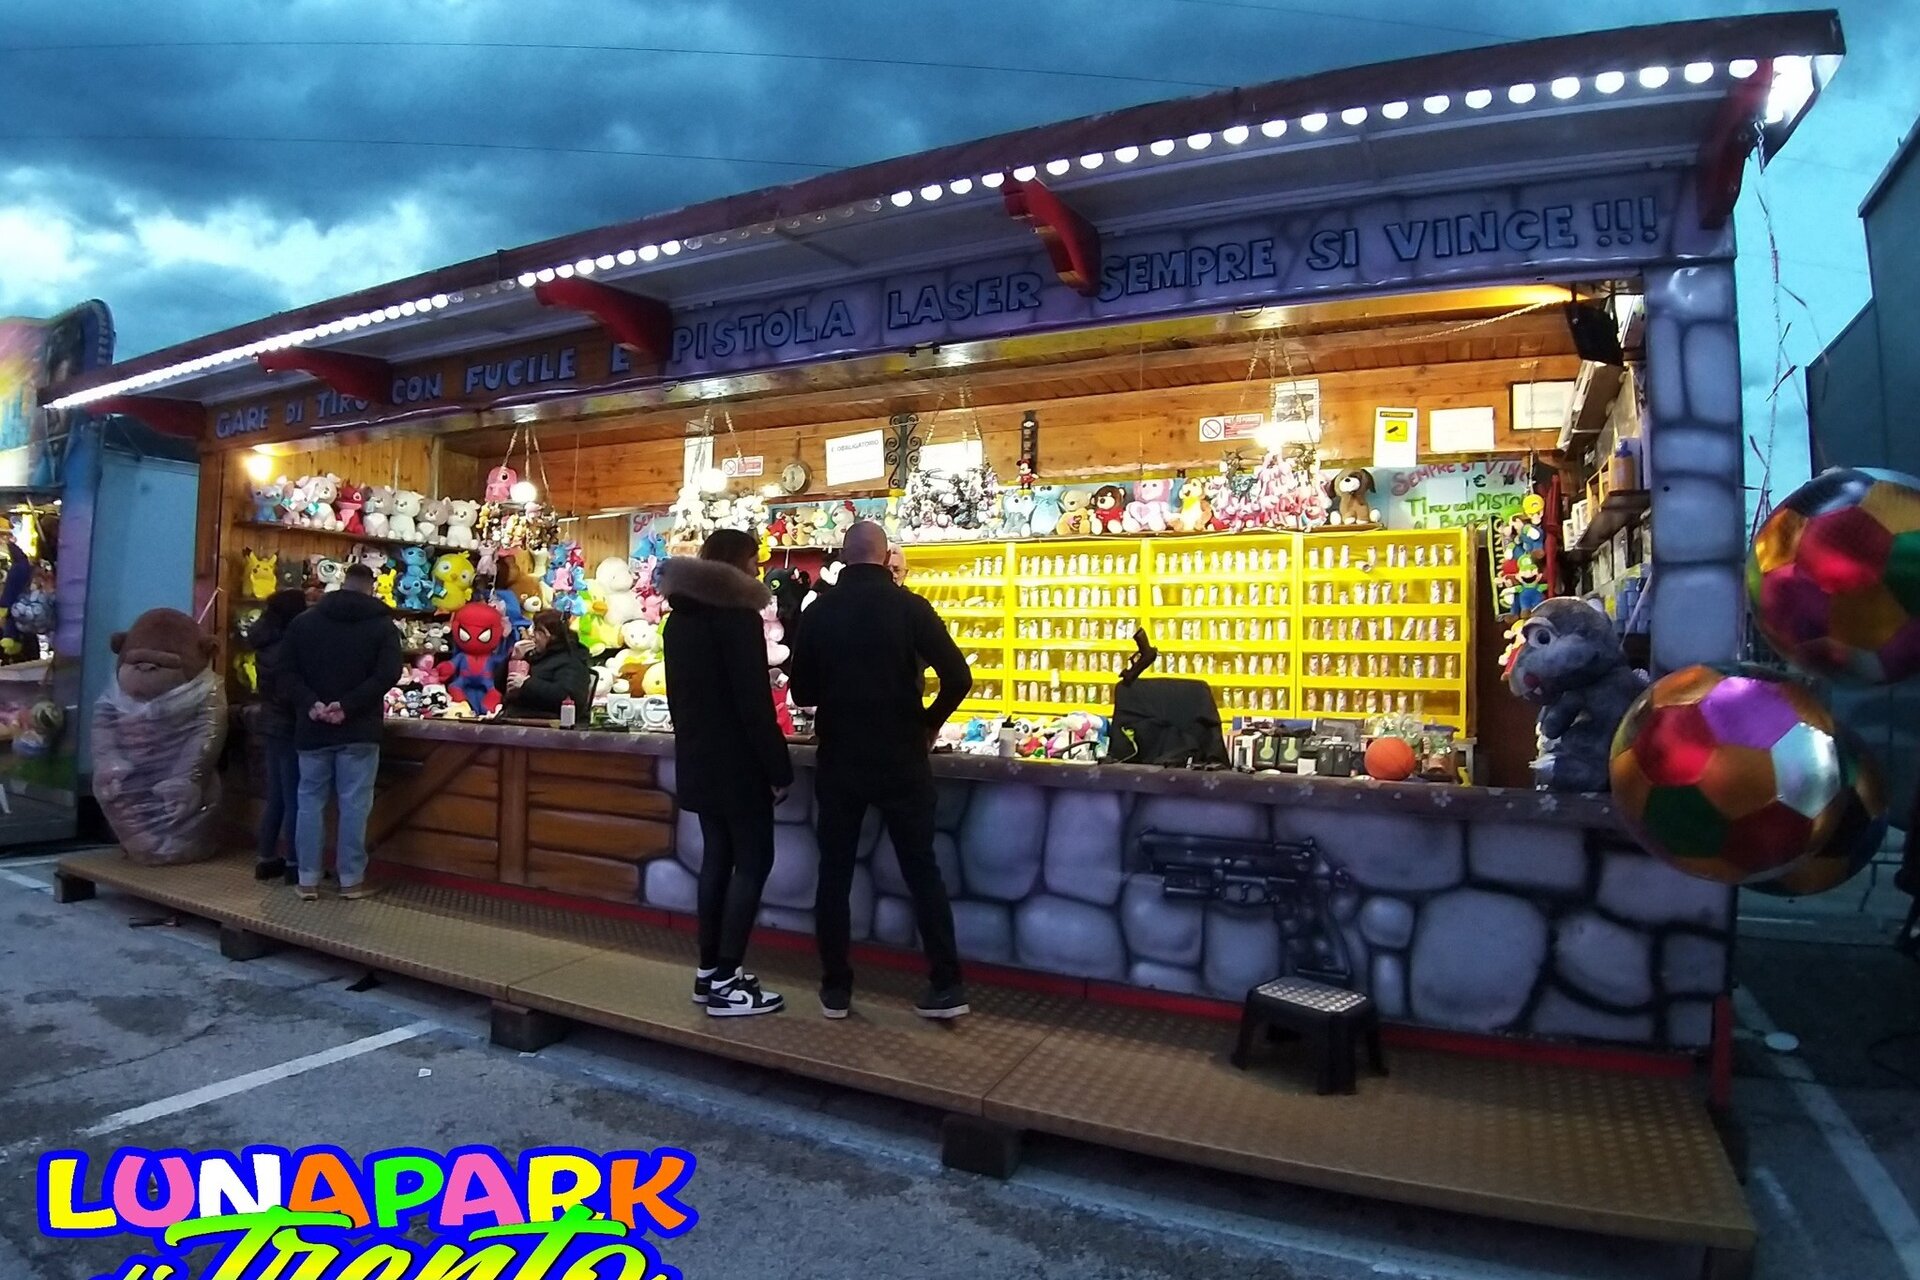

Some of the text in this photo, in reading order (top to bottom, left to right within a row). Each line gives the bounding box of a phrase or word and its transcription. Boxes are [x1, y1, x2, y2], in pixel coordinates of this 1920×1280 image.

[215, 404, 270, 440] GARE
[284, 402, 304, 424] DI
[391, 372, 443, 405] CON
[464, 347, 577, 394] FUCILE
[611, 342, 630, 374] E
[671, 300, 855, 365] PISTOLA
[887, 271, 1044, 330] LASER
[1098, 238, 1276, 302] SEMPRE
[1306, 229, 1359, 271] SI
[1385, 206, 1578, 263] VINCE
[1592, 197, 1657, 247] !!!
